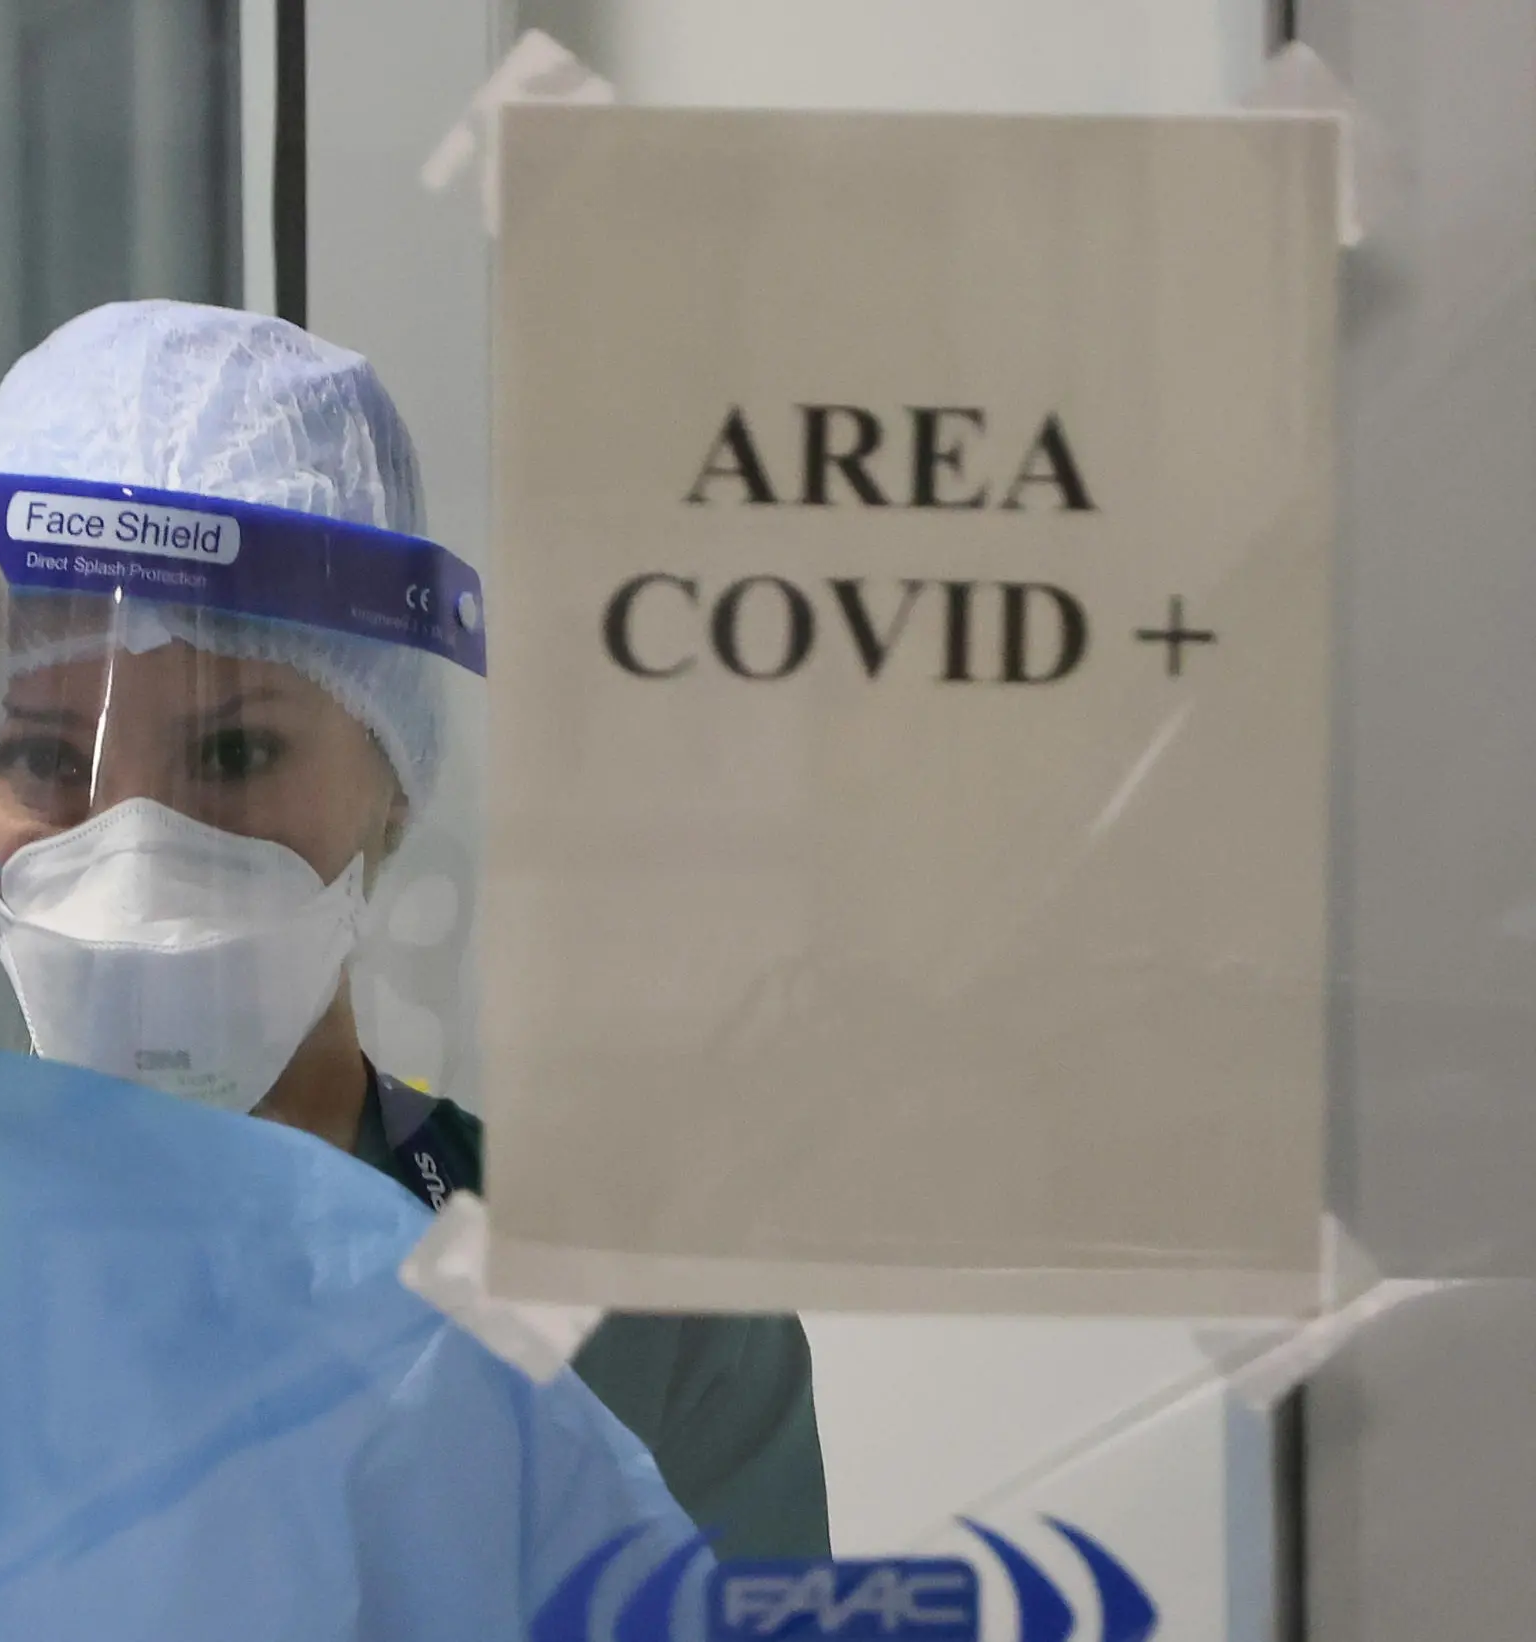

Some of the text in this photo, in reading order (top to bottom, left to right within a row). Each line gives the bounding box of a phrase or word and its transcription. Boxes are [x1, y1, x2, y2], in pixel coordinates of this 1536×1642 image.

[680, 402, 1101, 513] AREA
[26, 502, 222, 553] Face Shield
[26, 551, 208, 588] Direct Splash Protection
[406, 584, 431, 612] CE
[601, 571, 1217, 685] COVID +
[723, 1567, 965, 1635] FAAC
